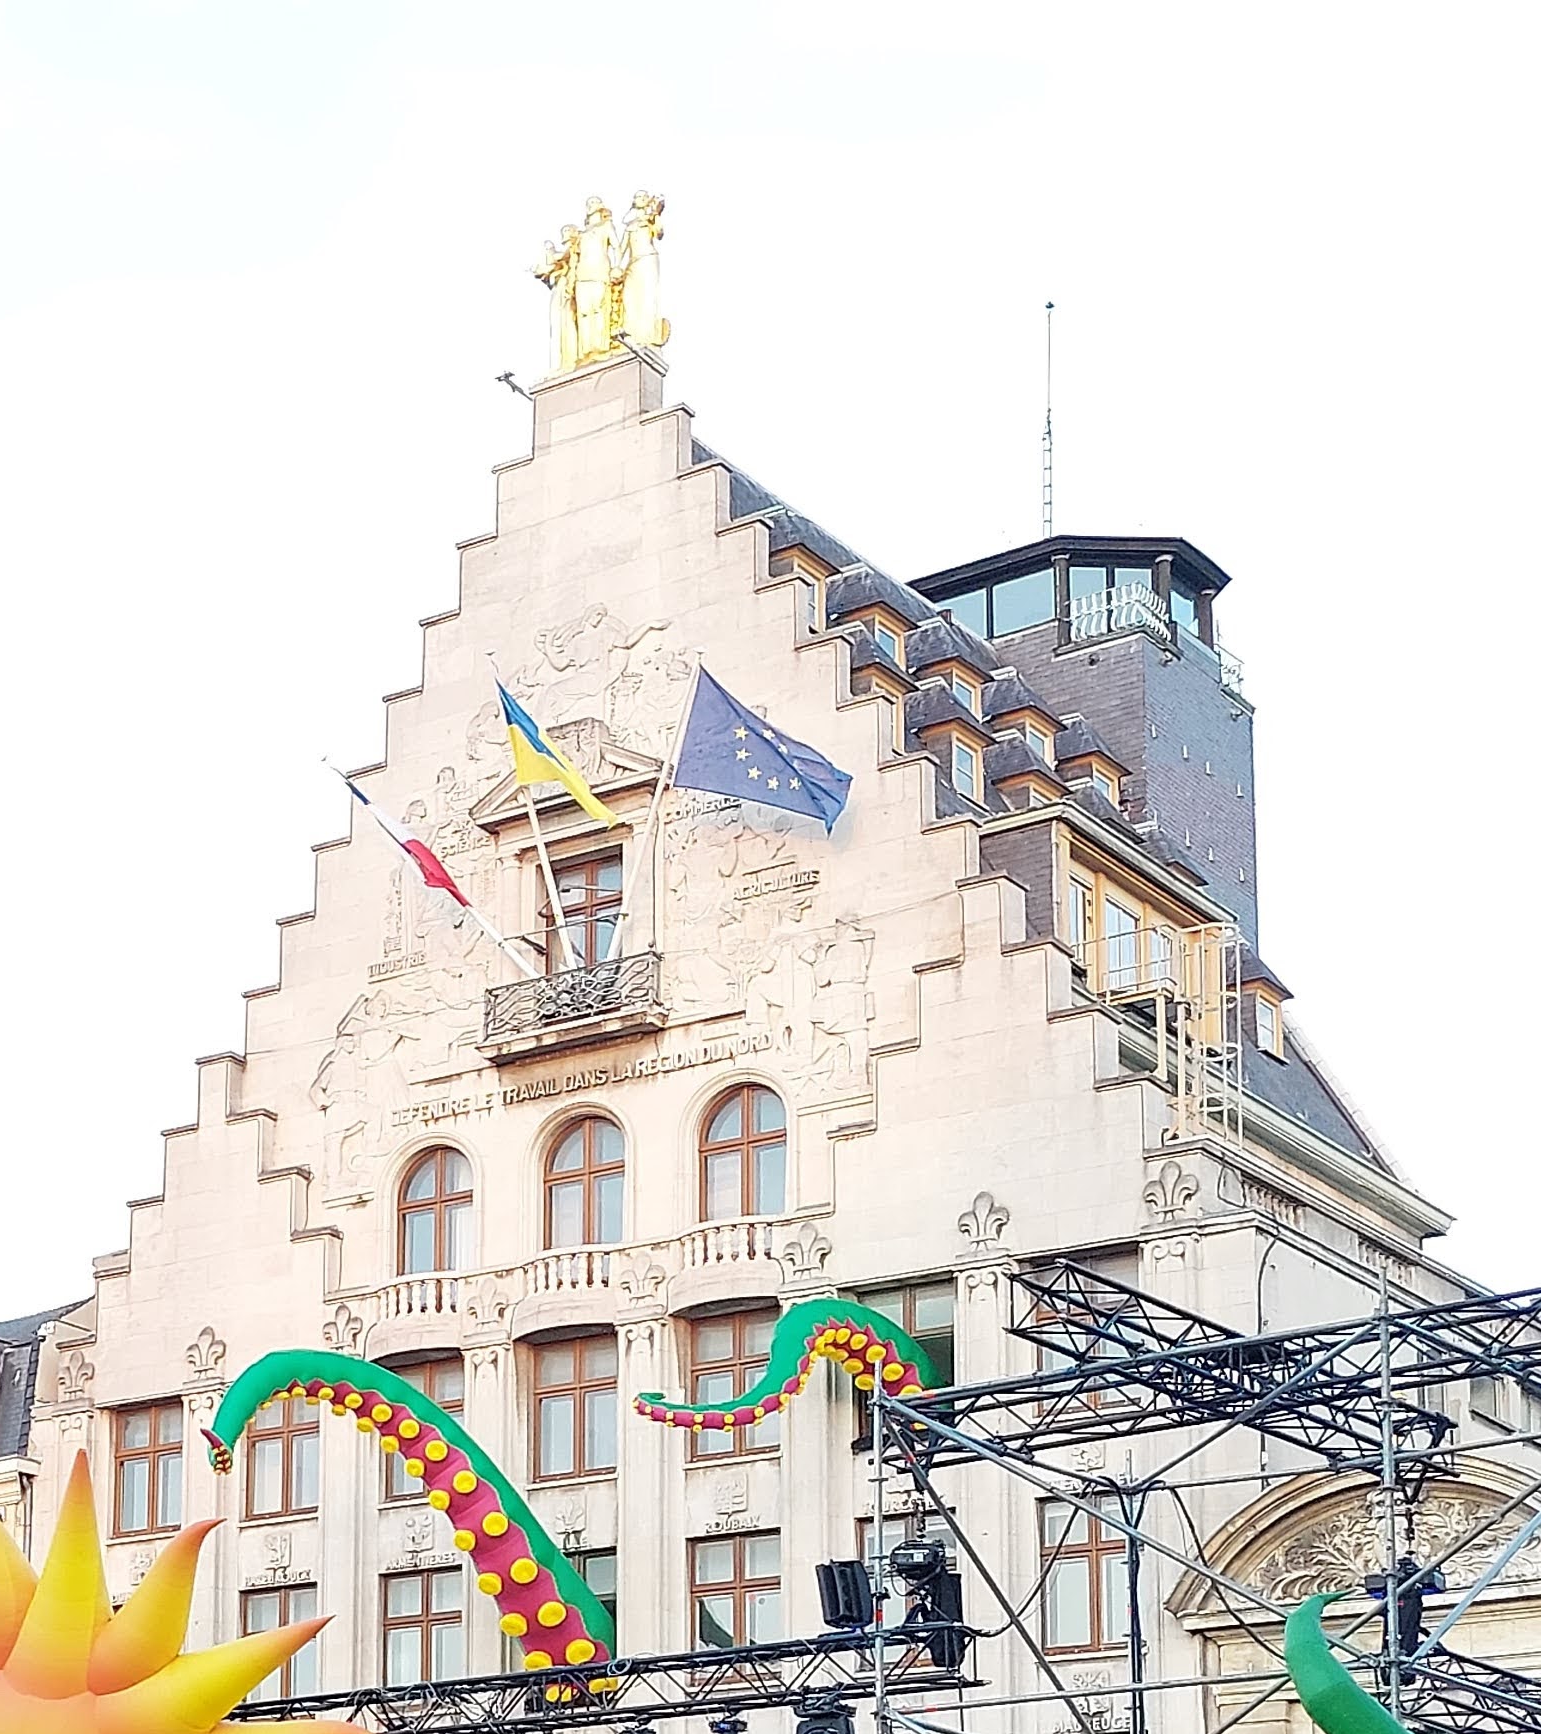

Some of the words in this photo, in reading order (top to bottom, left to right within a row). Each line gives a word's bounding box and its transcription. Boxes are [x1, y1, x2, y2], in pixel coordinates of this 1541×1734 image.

[502, 1082, 560, 1106] TRAVAIL
[564, 1066, 608, 1091] DANS
[611, 1062, 634, 1083] LA
[1053, 1715, 1132, 1734] MAUEUGE
